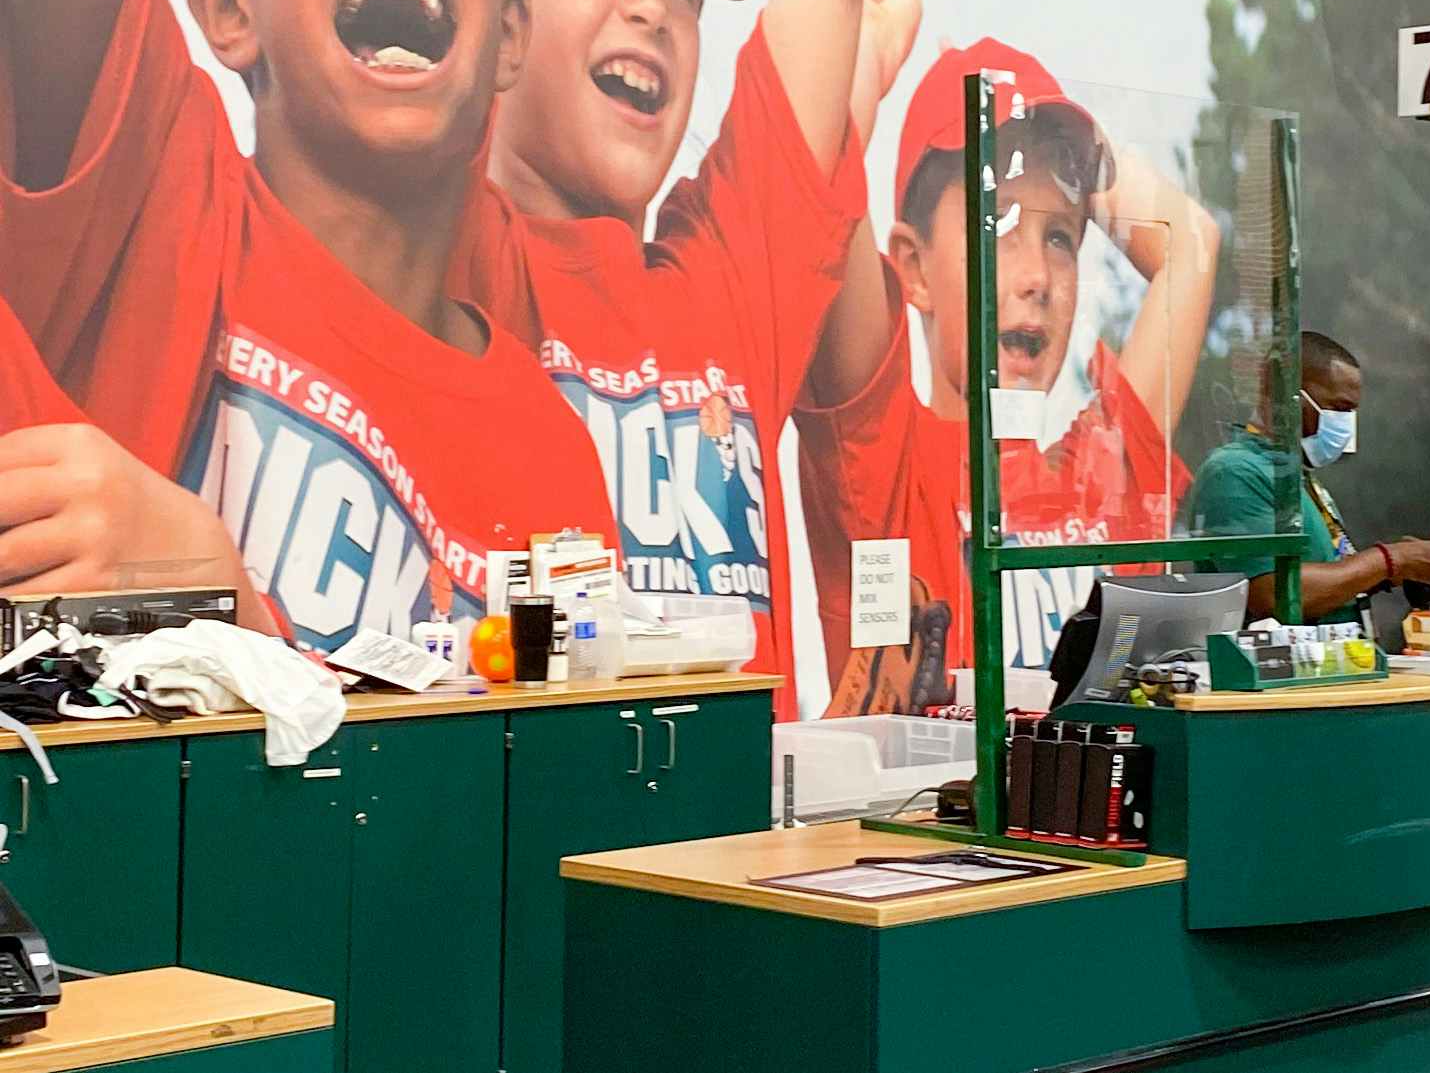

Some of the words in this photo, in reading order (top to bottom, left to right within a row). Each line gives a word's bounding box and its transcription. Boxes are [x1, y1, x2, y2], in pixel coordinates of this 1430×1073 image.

[587, 357, 660, 394] SEAS
[304, 379, 415, 505] SEASON
[859, 553, 892, 565] PLEASE
[859, 573, 874, 585] DO
[875, 572, 896, 585] NOT
[858, 611, 899, 624] SENSORS
